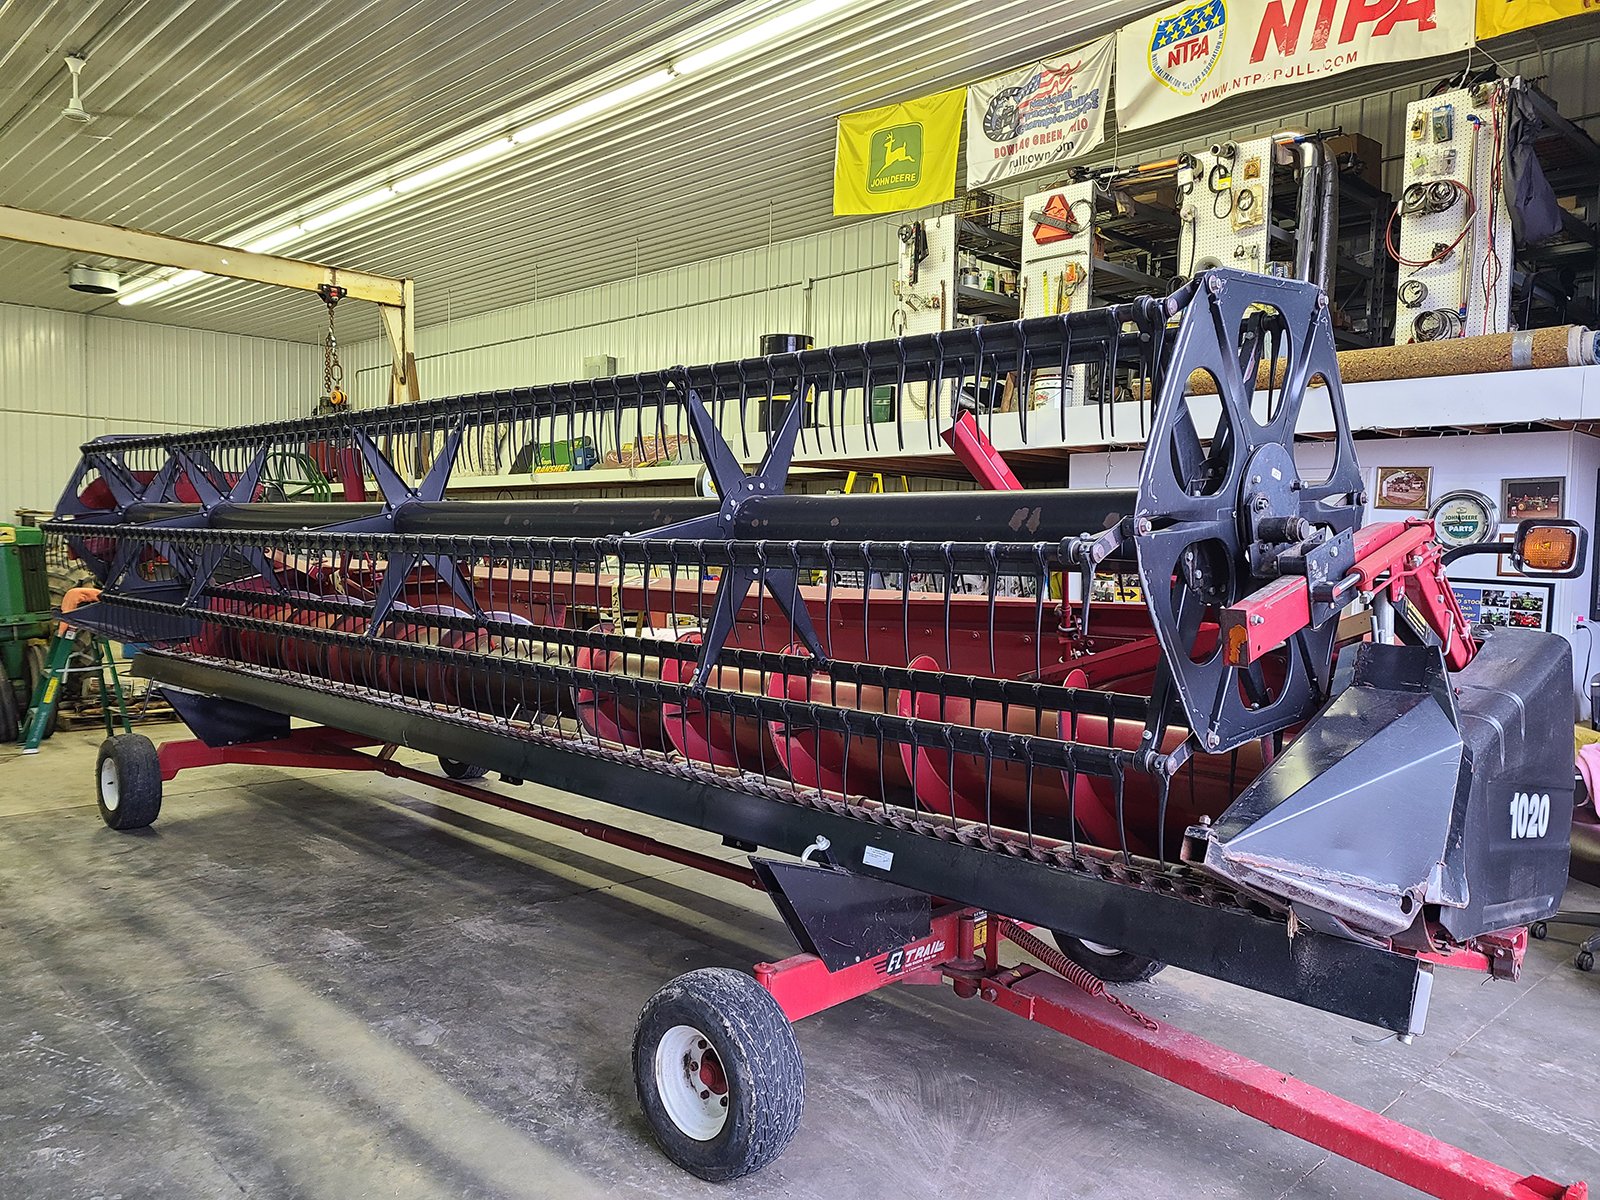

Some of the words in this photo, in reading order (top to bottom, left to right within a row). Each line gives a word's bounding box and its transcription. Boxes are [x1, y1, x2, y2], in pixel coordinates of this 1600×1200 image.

[1249, 0, 1437, 64] NTPA
[1167, 35, 1209, 69] NTPA
[871, 177, 890, 188] JOHN
[890, 173, 916, 184] DEERE
[1510, 792, 1550, 839] 1020
[906, 940, 946, 963] TRAIL
